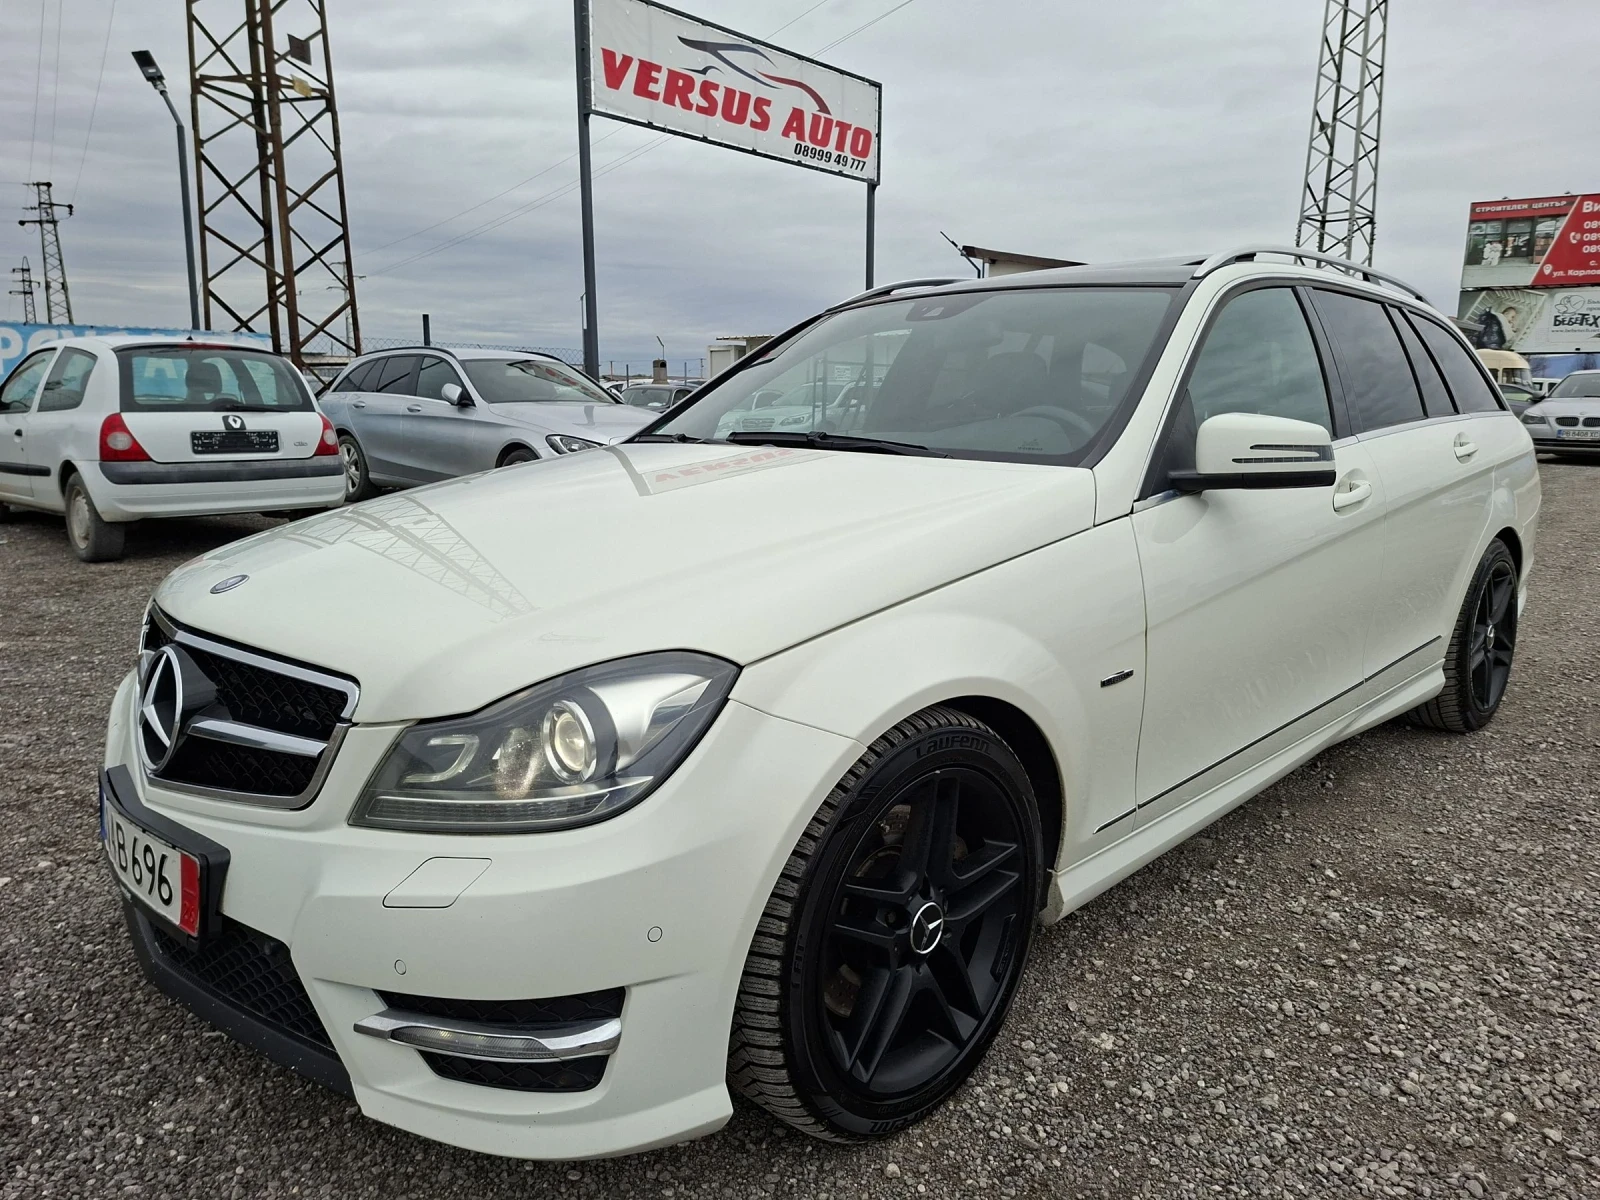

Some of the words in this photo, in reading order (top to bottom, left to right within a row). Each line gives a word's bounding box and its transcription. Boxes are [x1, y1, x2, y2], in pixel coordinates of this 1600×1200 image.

[601, 47, 772, 132] VERSUS
[781, 107, 873, 159] AUTO
[794, 142, 832, 164] 08999
[834, 153, 848, 168] 49
[850, 157, 866, 173] 777
[912, 735, 991, 758] Laufenn
